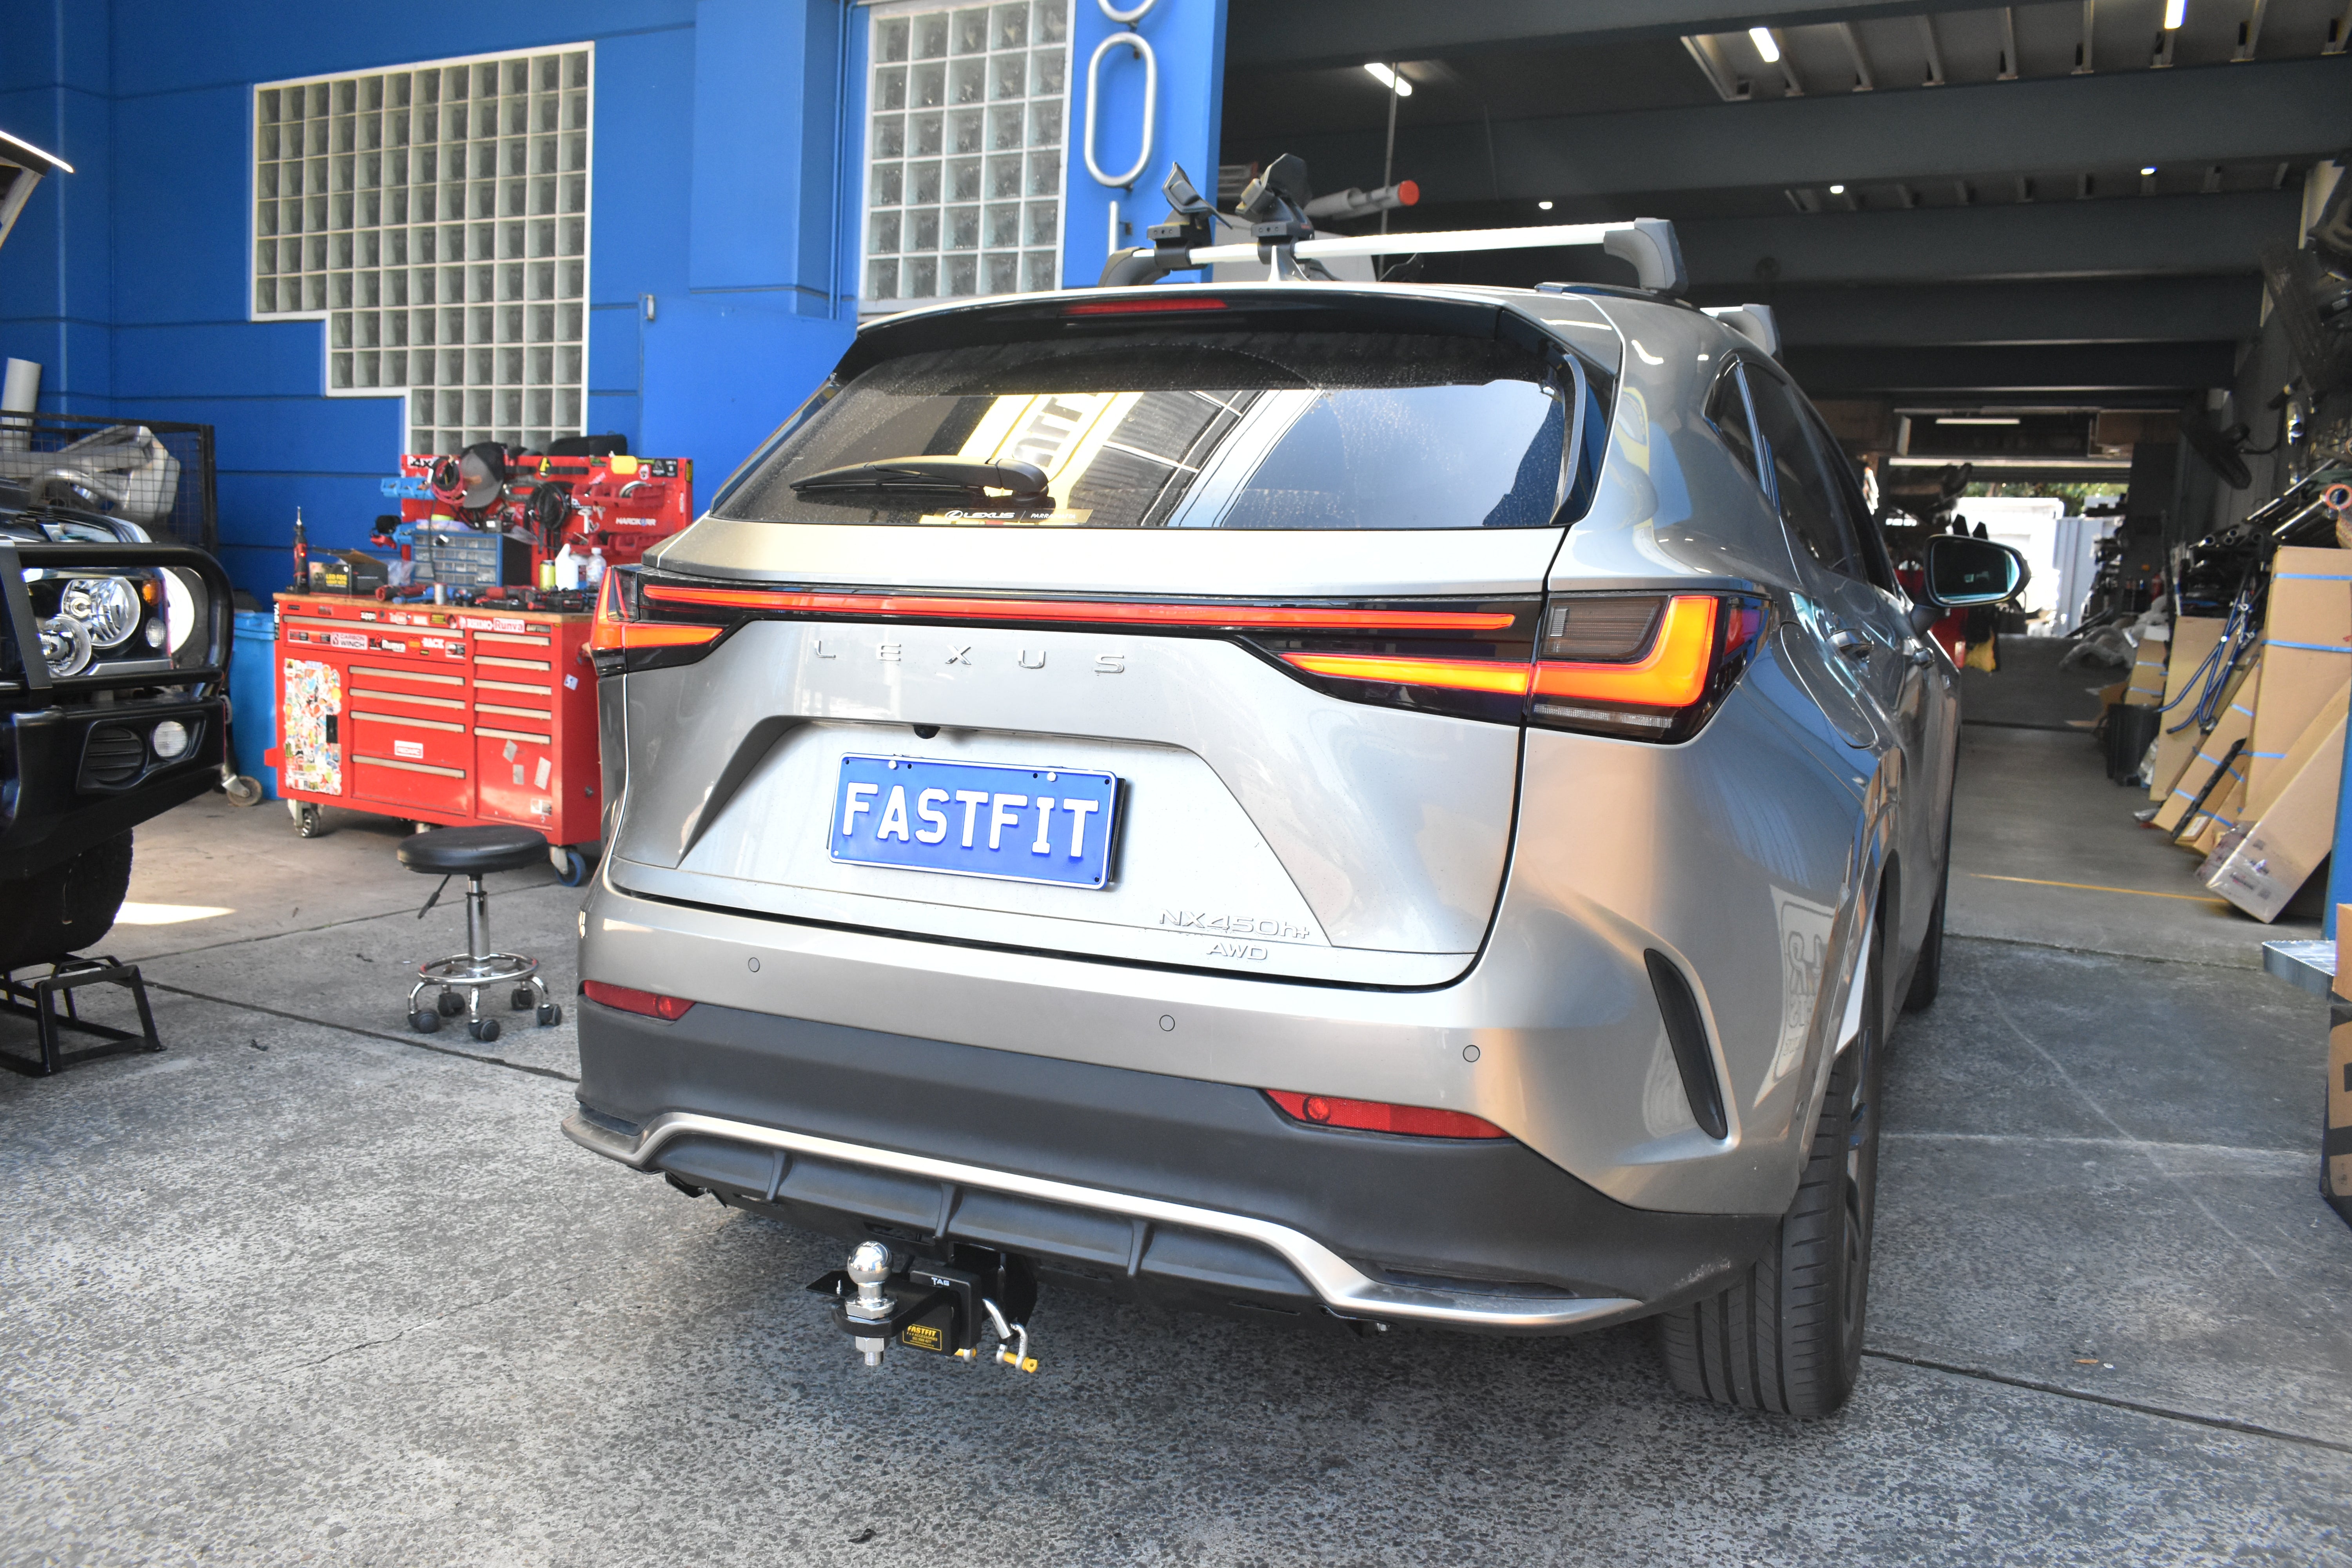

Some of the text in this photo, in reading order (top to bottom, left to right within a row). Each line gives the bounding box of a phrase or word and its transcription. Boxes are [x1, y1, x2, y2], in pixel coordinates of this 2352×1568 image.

[495, 620, 523, 631] Runva
[340, 640, 365, 648] WINCH
[814, 640, 1125, 673] LEXUS
[842, 782, 1099, 857] FASTFIT
[1206, 943, 1268, 960] AWD
[931, 1277, 949, 1286] TAG
[907, 1325, 937, 1337] FASTFIT
